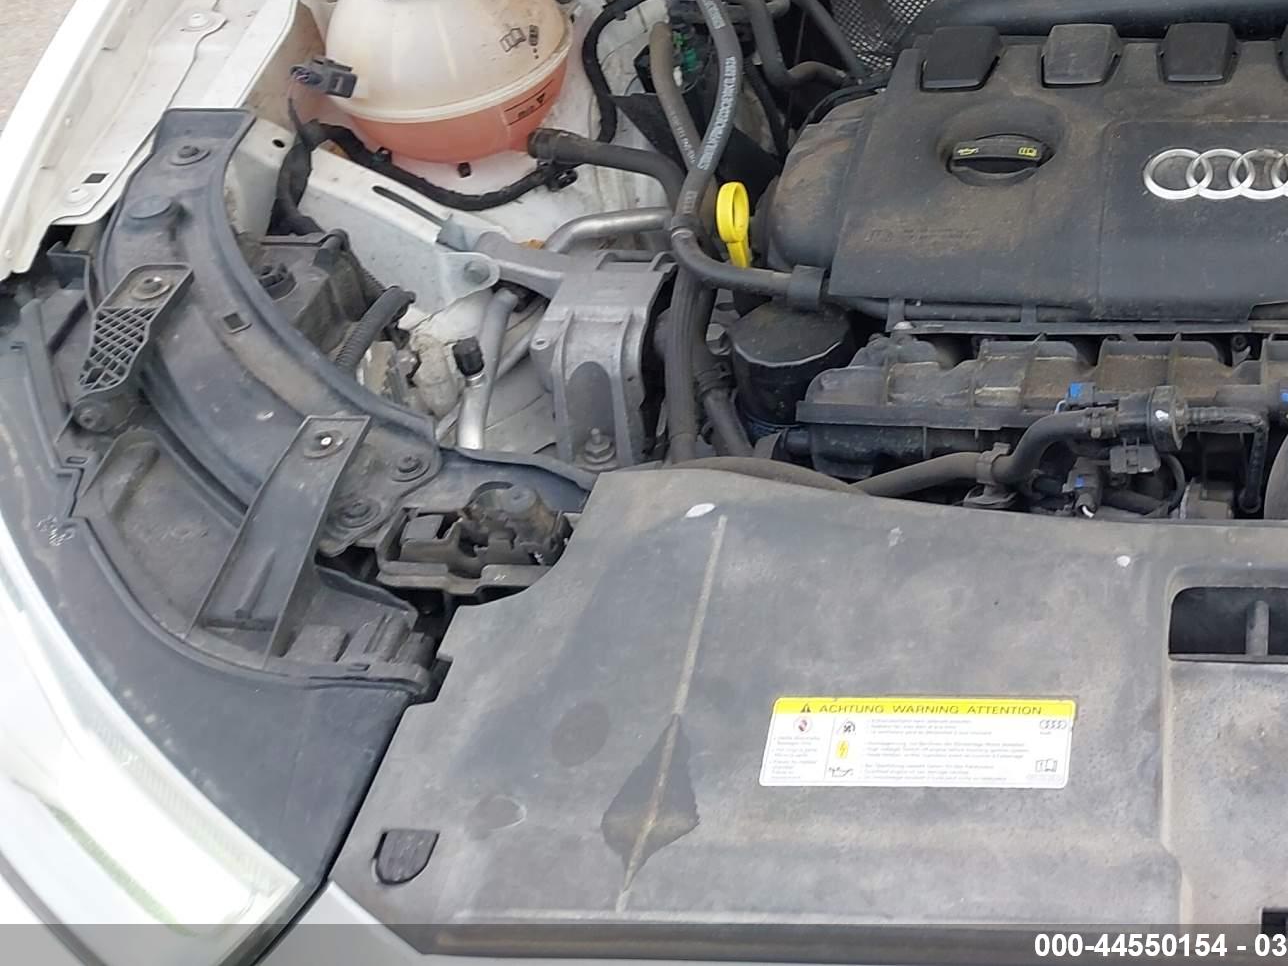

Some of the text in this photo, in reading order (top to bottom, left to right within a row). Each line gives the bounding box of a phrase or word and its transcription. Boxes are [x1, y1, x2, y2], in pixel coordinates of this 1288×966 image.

[818, 703, 1043, 716] ACHTUNG WARNING ATTENTION
